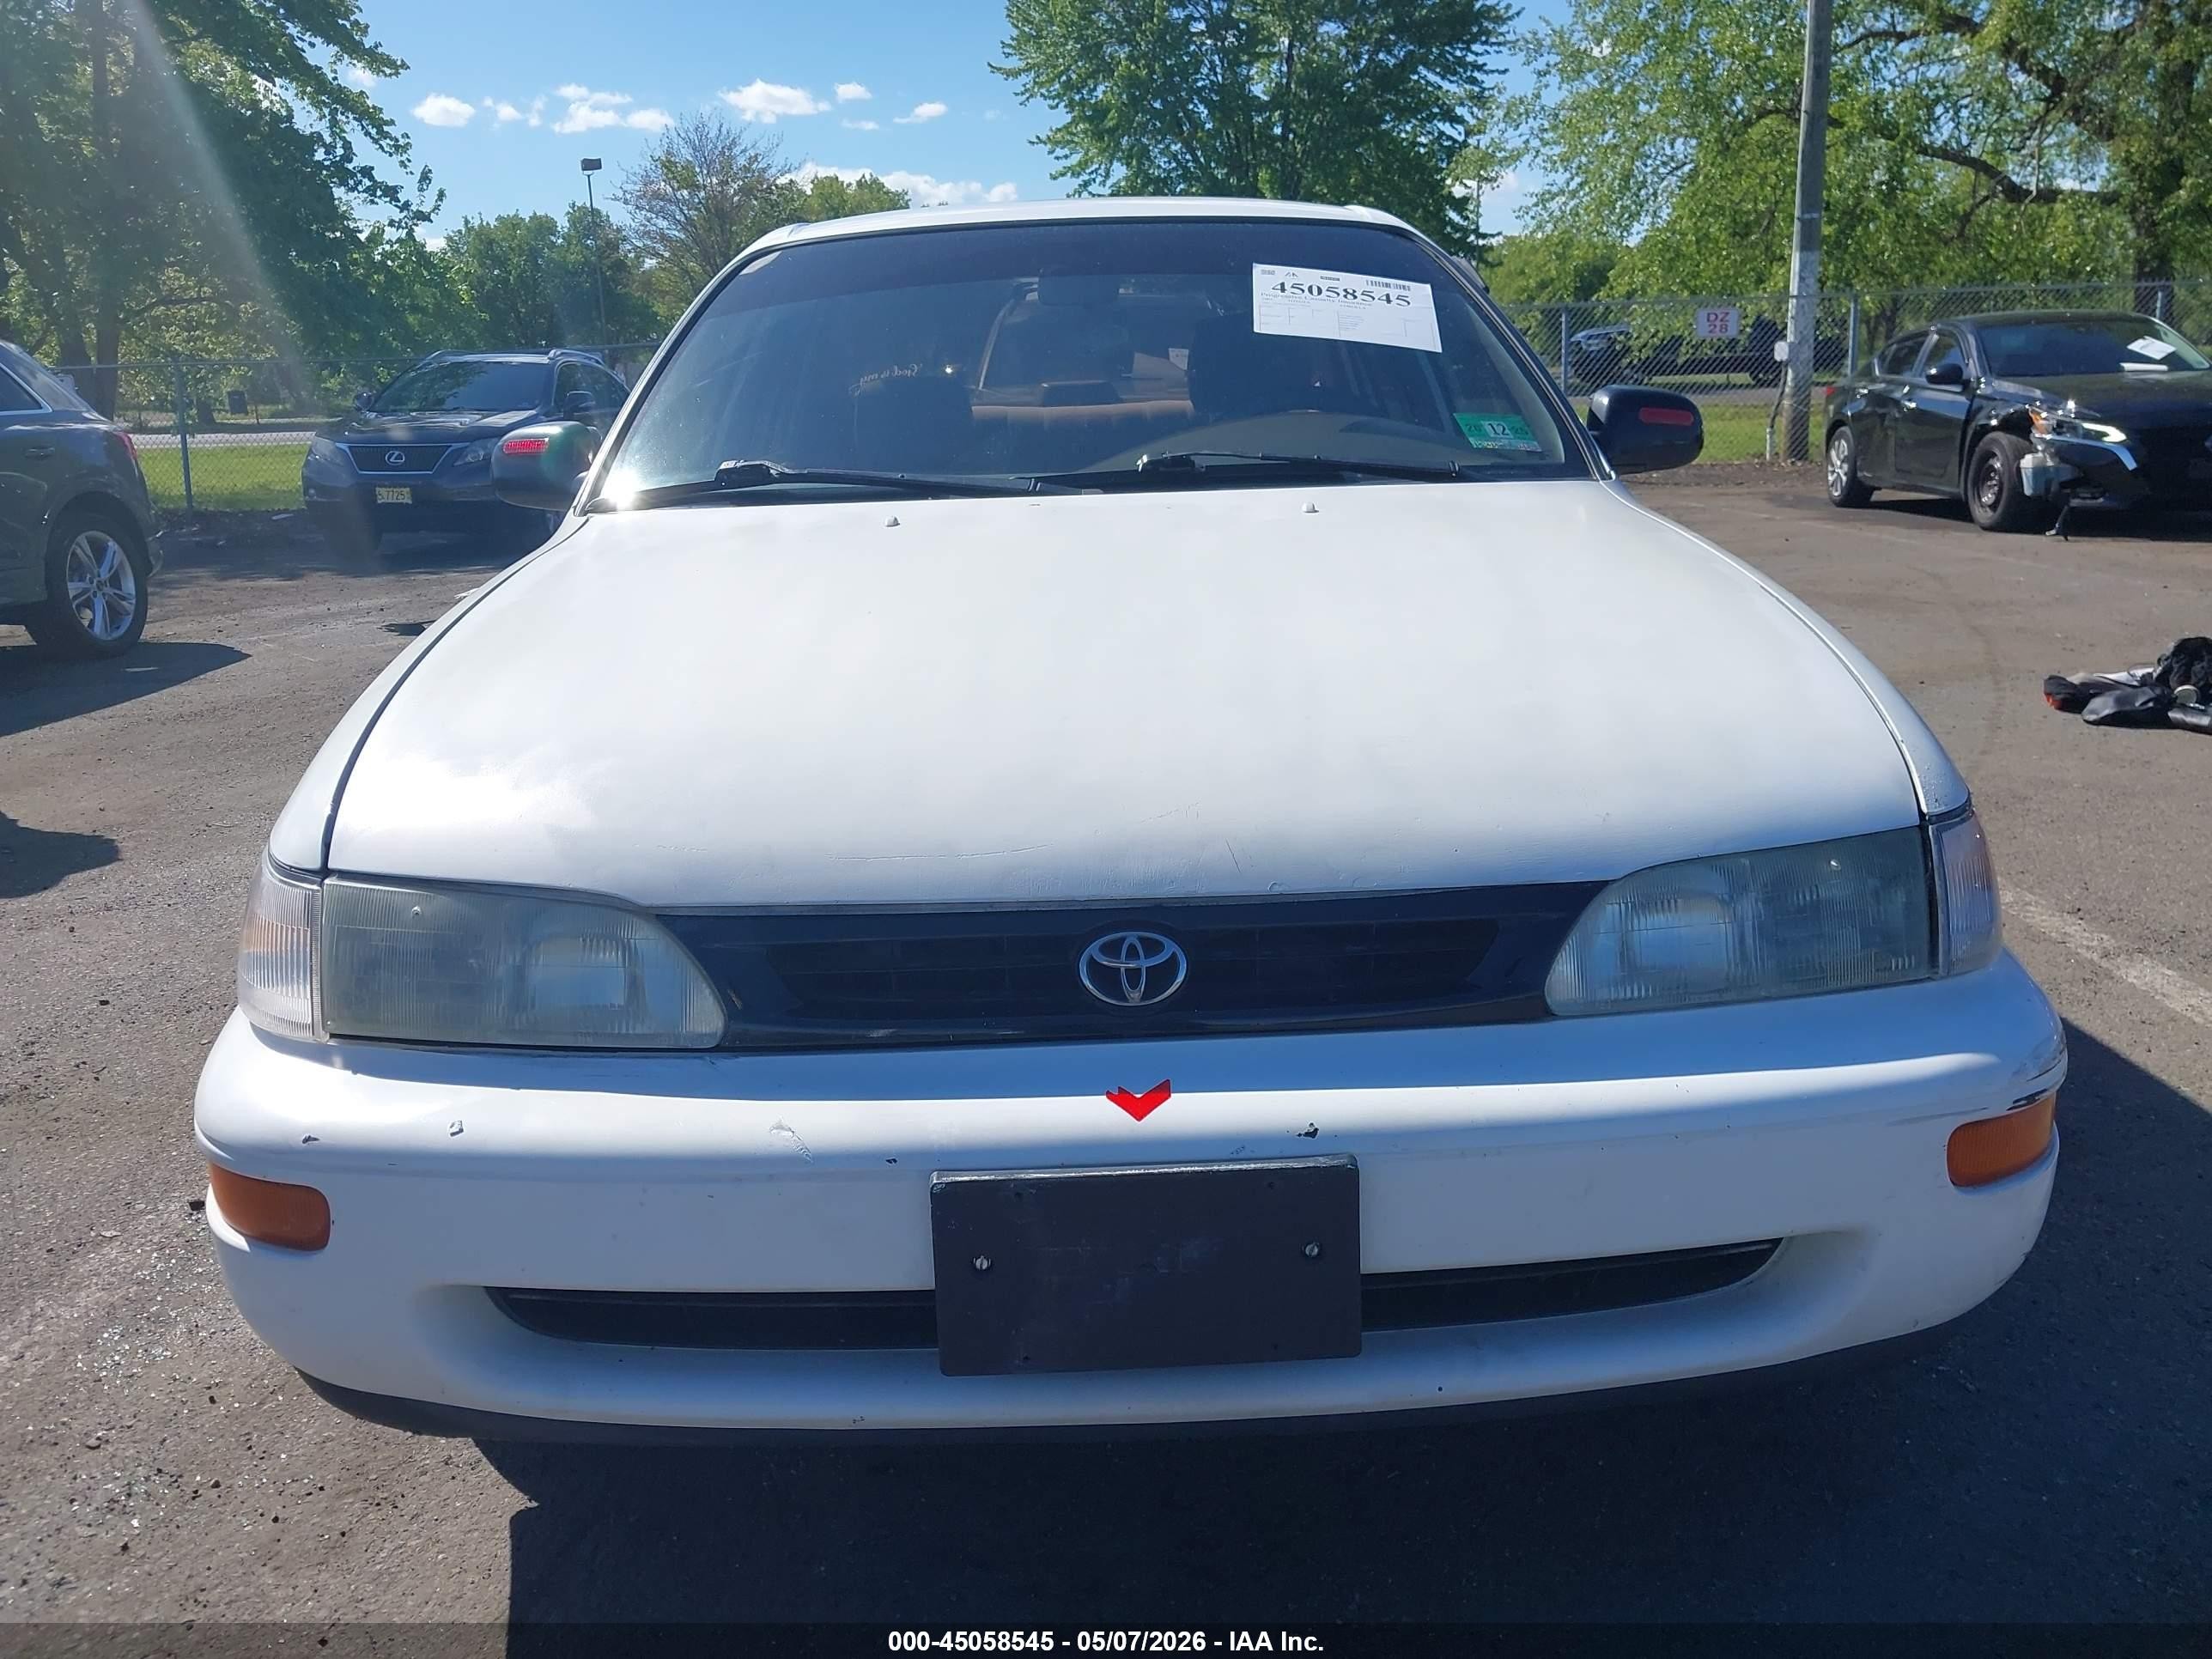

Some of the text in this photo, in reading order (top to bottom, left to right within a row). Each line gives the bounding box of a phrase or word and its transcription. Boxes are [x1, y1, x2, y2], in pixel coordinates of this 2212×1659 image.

[1271, 281, 1412, 307] 45058545
[1708, 323, 1729, 333] 28
[1487, 422, 1510, 436] 12
